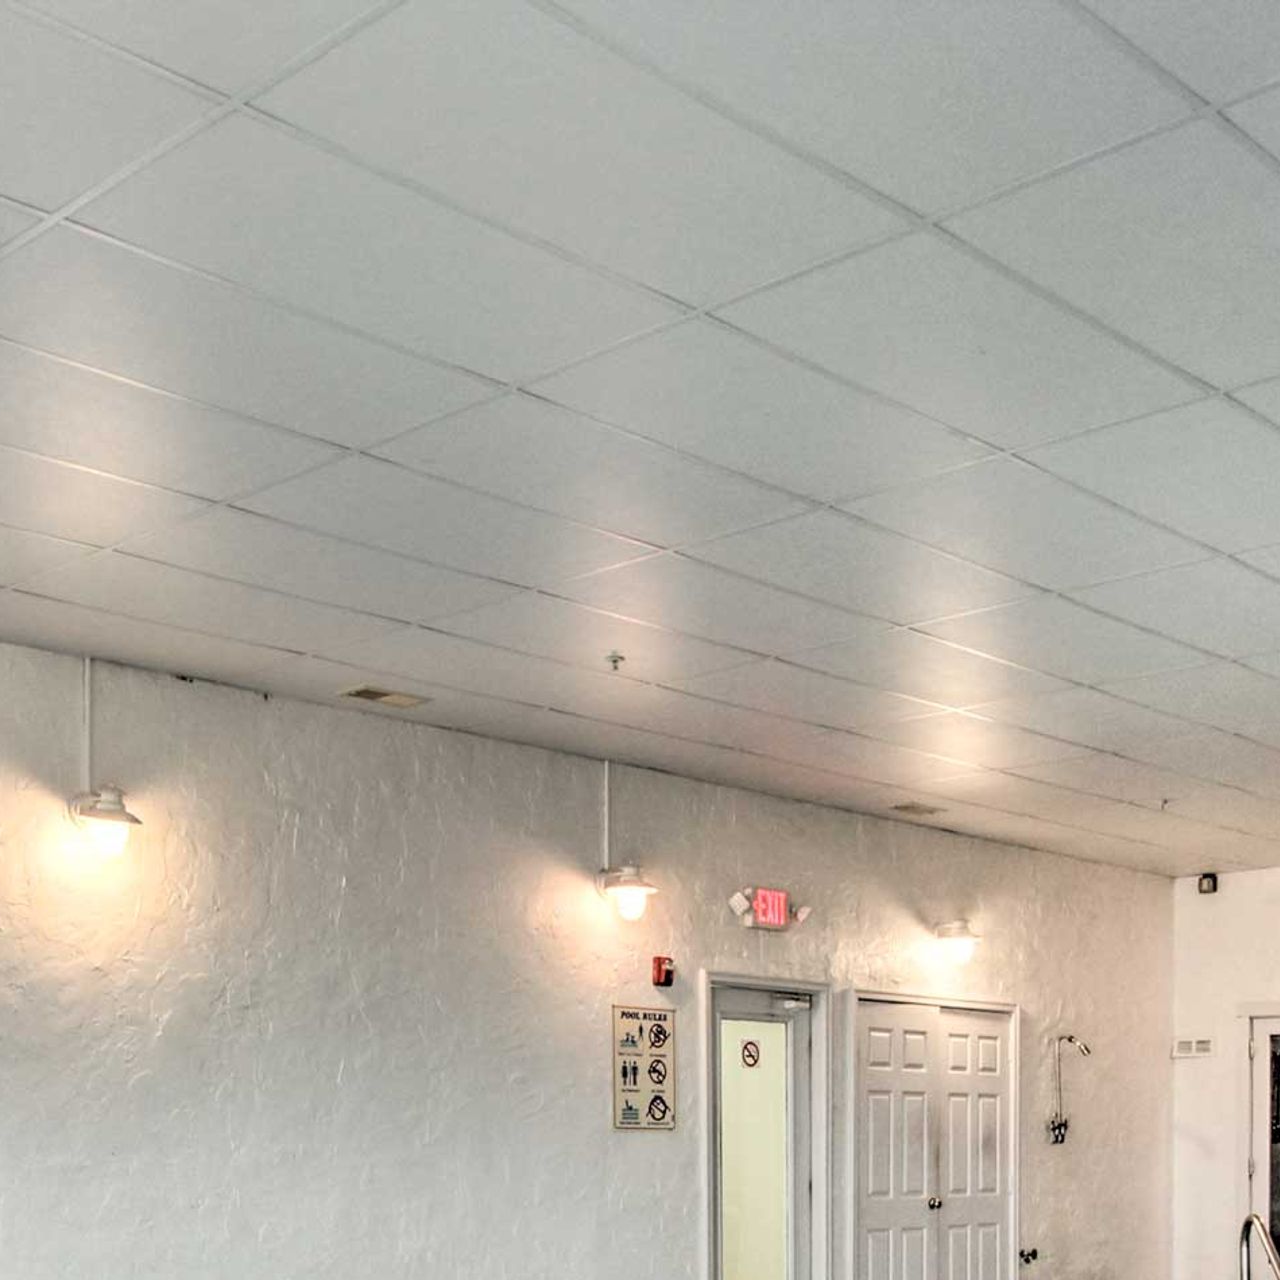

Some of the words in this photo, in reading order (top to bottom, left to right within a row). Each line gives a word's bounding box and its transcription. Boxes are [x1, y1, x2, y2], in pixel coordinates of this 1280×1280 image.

[756, 889, 787, 926] EXIT
[620, 1011, 640, 1020] POOL
[642, 1012, 667, 1021] RULES
